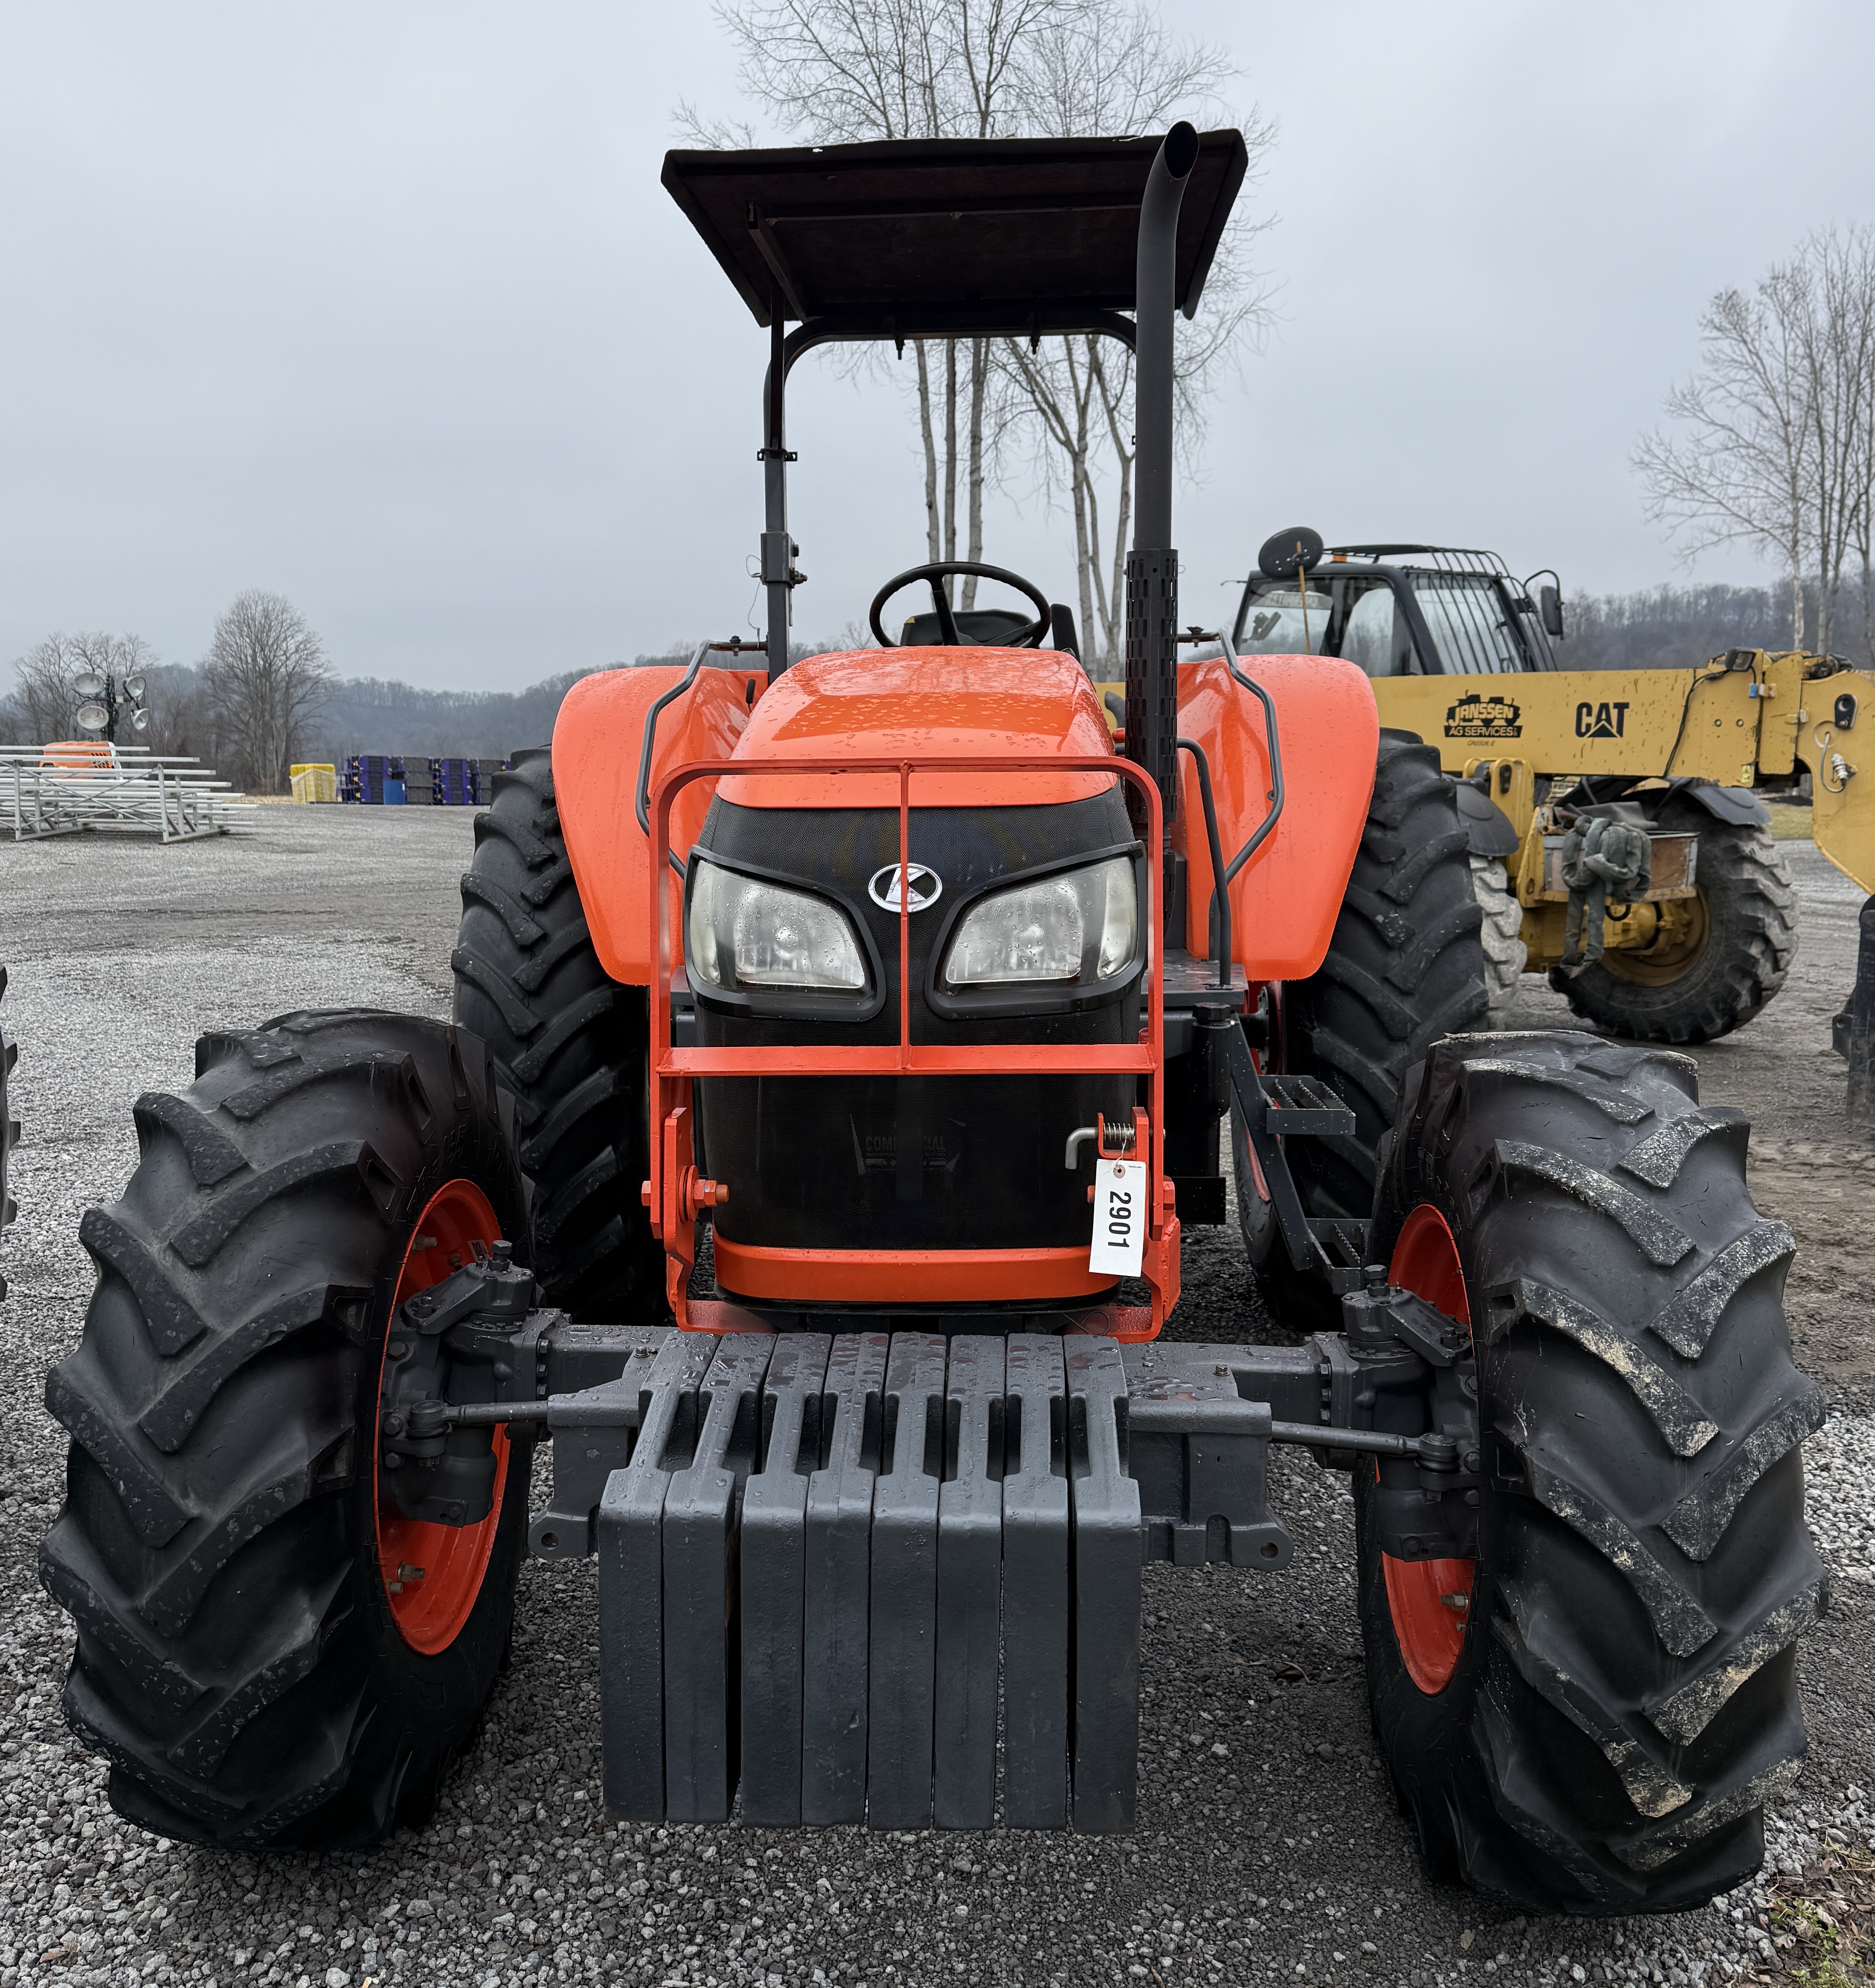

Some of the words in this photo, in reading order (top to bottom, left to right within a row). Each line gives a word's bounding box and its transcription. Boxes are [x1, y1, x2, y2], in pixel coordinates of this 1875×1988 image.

[1448, 703, 1514, 726] JANSSEN
[1575, 701, 1630, 738] CAT
[1449, 727, 1463, 736] AG
[1464, 726, 1513, 736] SERVICES
[1108, 1191, 1132, 1248] 2901
